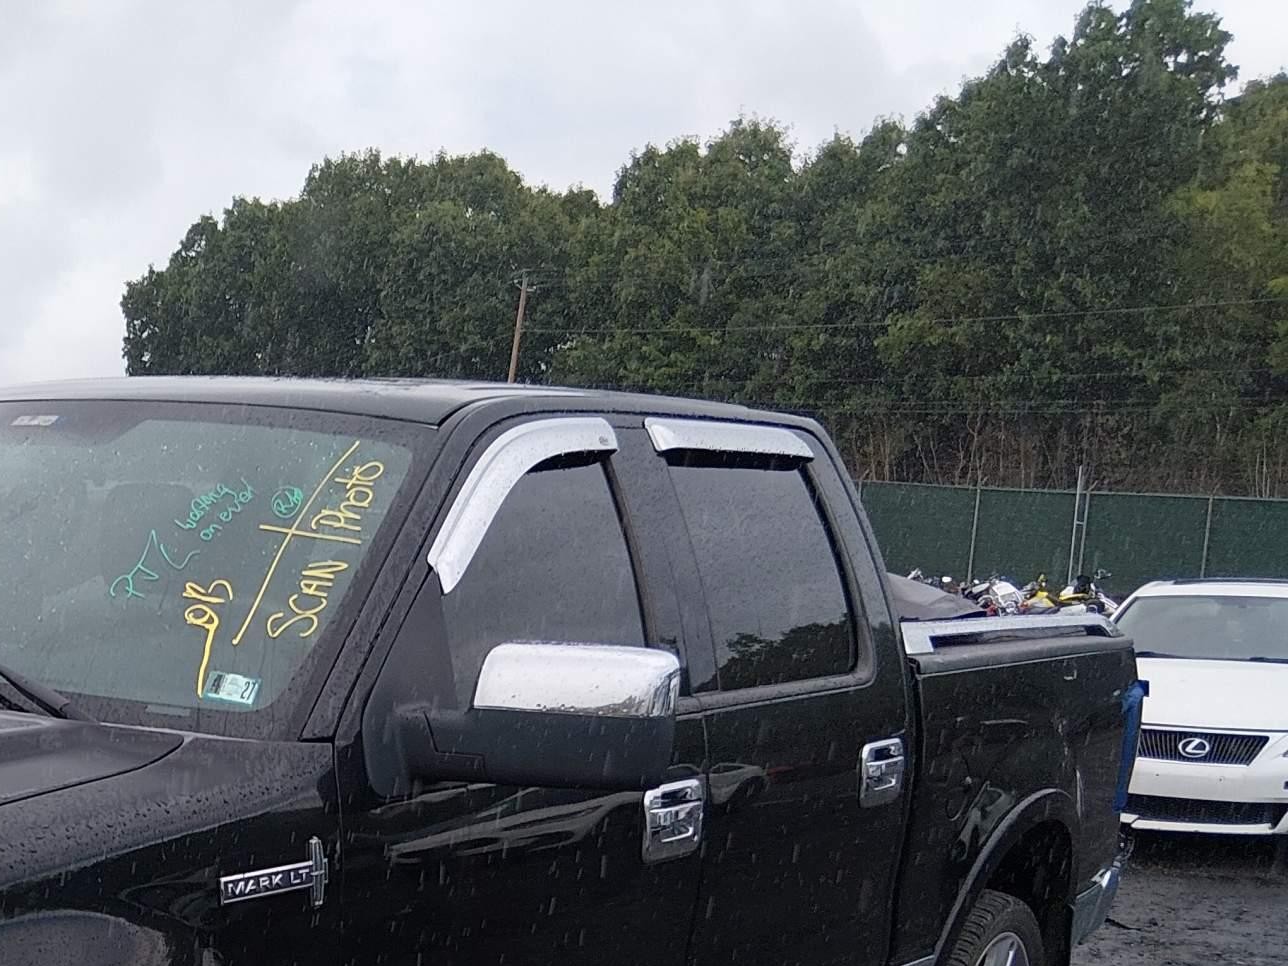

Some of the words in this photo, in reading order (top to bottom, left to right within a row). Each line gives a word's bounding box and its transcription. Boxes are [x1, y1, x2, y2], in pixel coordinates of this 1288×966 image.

[266, 560, 350, 638] SCAN
[227, 873, 283, 897] MARK
[290, 868, 310, 884] LT
